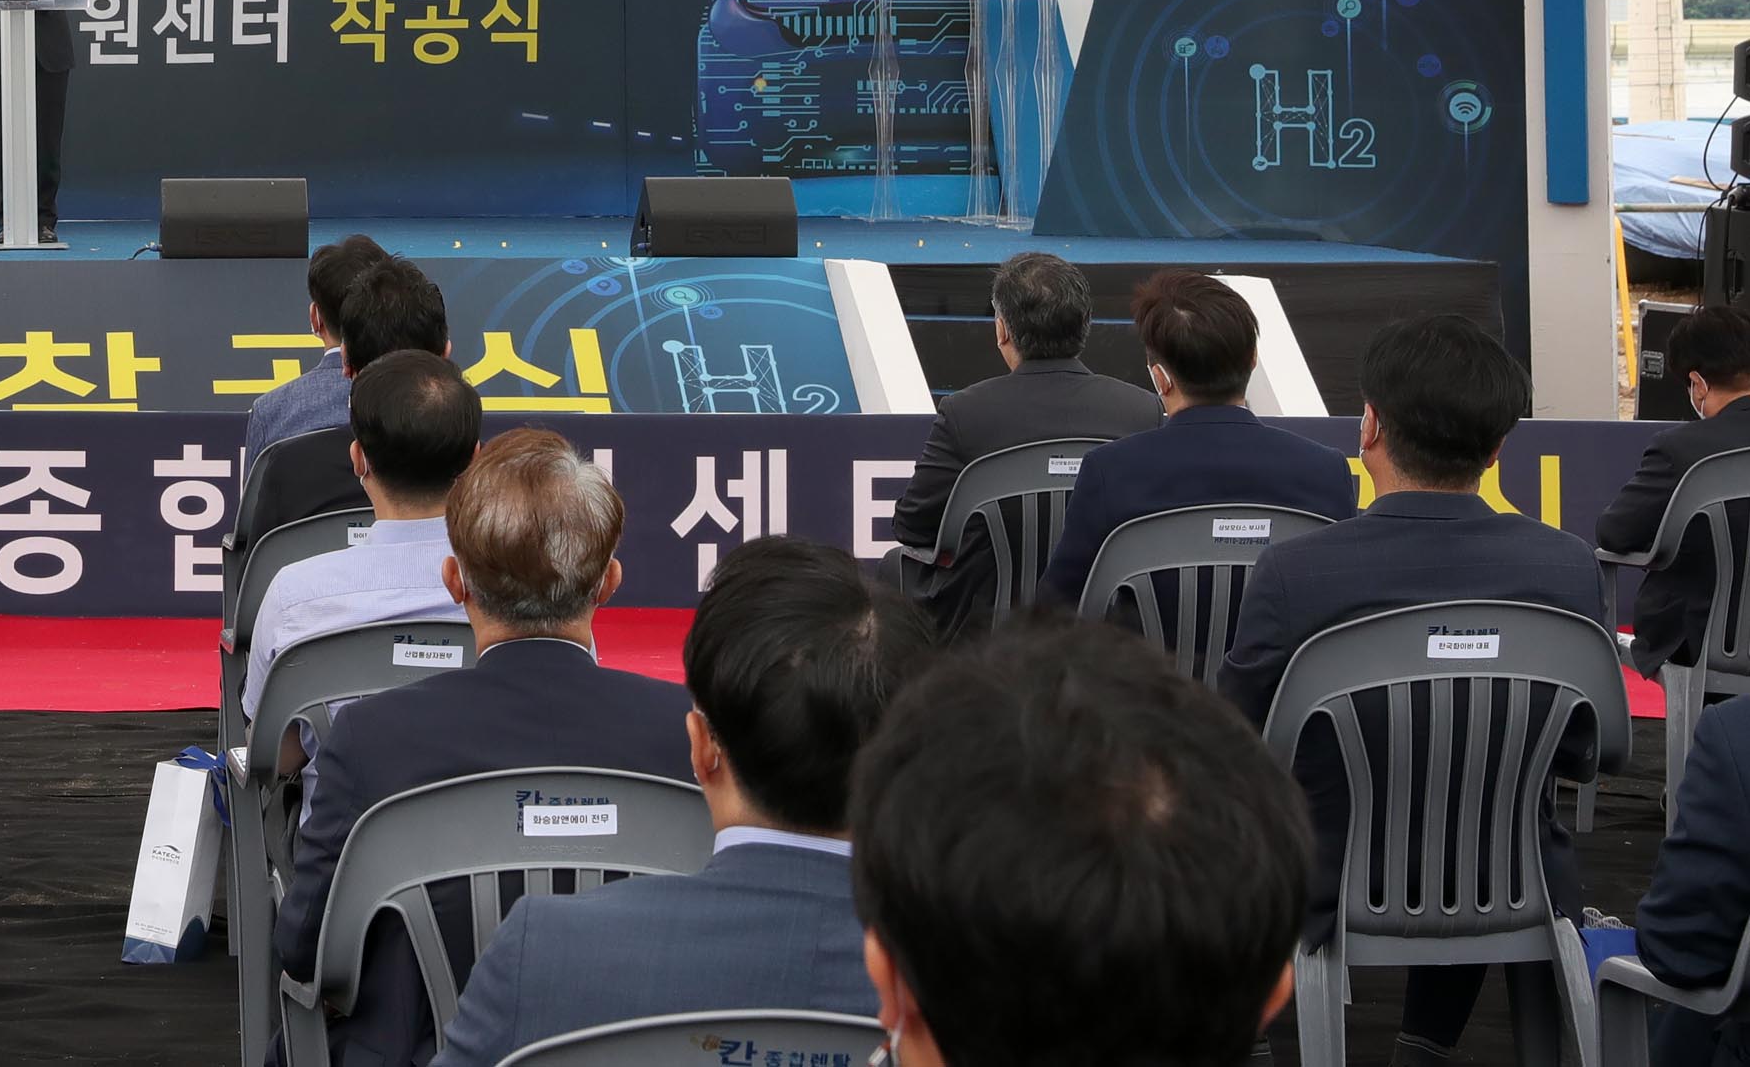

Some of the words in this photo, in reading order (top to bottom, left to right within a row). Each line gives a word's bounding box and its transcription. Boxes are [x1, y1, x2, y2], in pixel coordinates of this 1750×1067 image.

[1438, 642, 1474, 650] 한국화이바
[1476, 642, 1489, 650] 대표
[404, 651, 452, 659] 산업통상자원부
[533, 815, 588, 825] 화승알앤에이
[591, 814, 609, 823] 전무
[152, 849, 181, 860] KATECH
